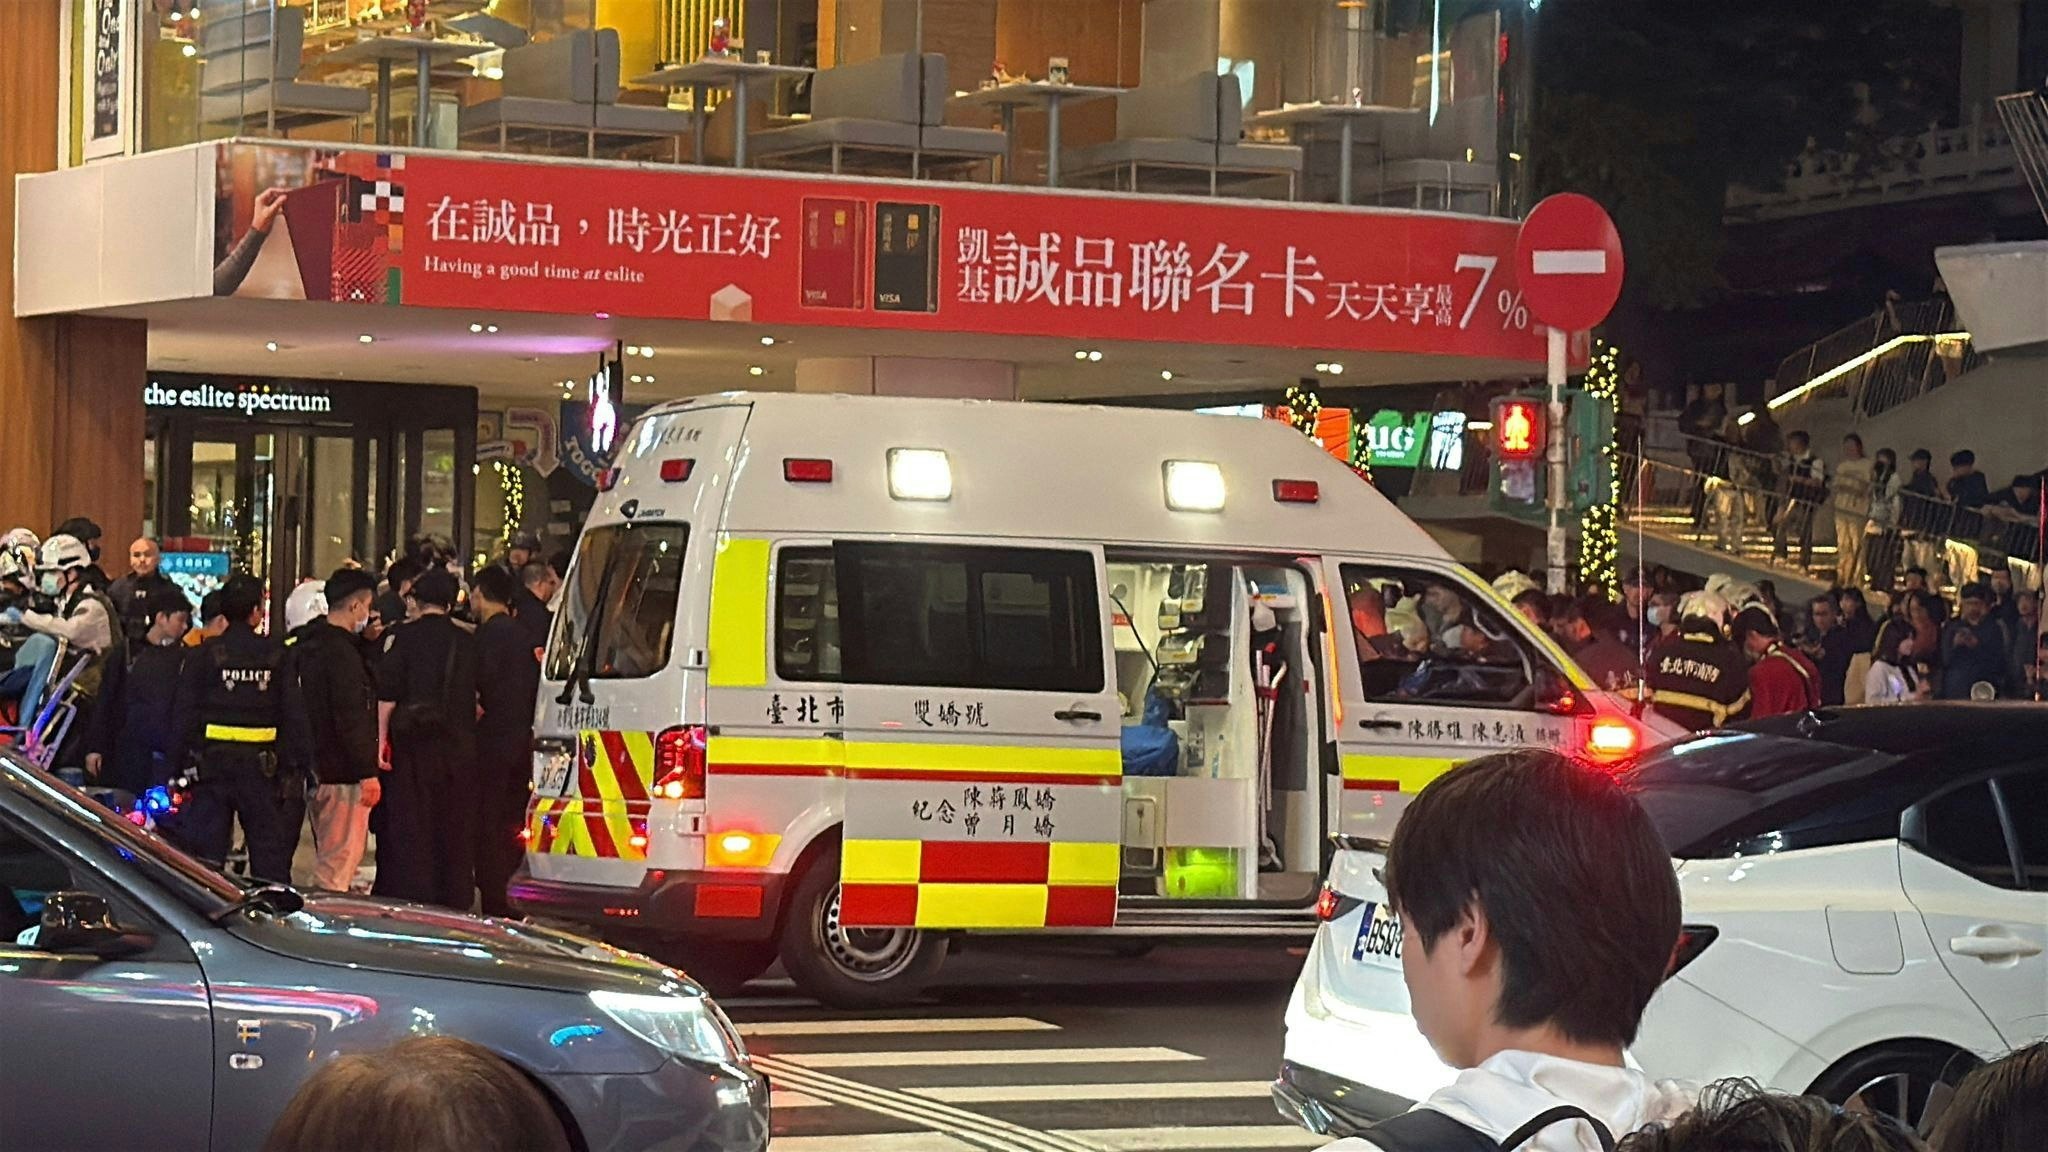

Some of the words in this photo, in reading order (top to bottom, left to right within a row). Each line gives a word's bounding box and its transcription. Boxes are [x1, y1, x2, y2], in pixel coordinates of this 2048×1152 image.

[425, 256, 482, 278] Having
[487, 264, 495, 275] a
[501, 262, 539, 280] good
[544, 264, 580, 279] time
[584, 268, 601, 280] at
[604, 266, 645, 283] eslite
[879, 294, 901, 303] VISA
[144, 382, 177, 406] the
[180, 384, 235, 408] eslite
[238, 391, 331, 415] spectrum
[222, 669, 272, 682] POLICE
[912, 799, 956, 824] 紀念
